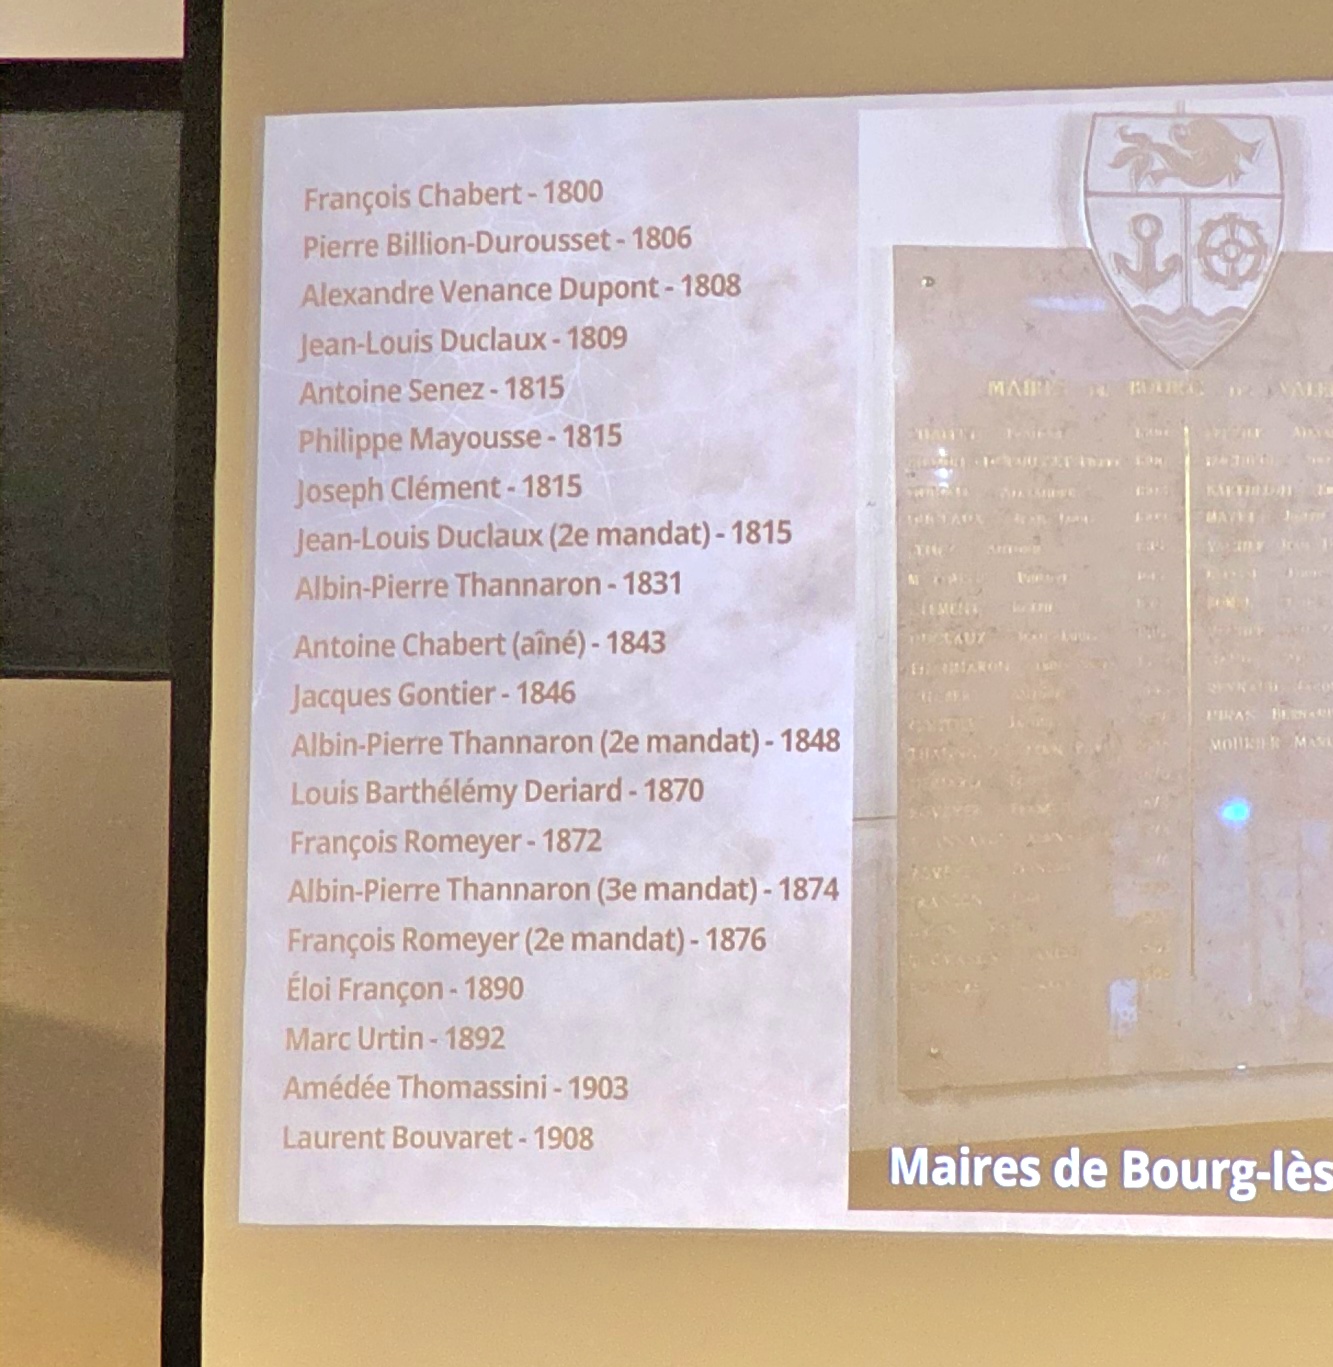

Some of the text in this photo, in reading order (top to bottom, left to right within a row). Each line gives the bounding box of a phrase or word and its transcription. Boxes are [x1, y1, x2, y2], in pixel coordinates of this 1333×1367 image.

[305, 179, 603, 216] François Chabert 1800
[304, 225, 692, 259] Pierre Billion-Durousset 1806
[301, 273, 741, 307] Alexandre Venance Dupont 1808
[298, 326, 627, 363] Jean-Louis Duclaux 1809
[299, 374, 565, 405] Antoine Senez 1815
[300, 423, 622, 460] Philippe Mayousse 1815
[294, 474, 582, 509] Joseph Clément 1815
[294, 519, 792, 557] Jean-Louis Duclaux (2e mandat) 1815
[295, 571, 680, 600] Albin-Pierre Thannaron 1831
[293, 629, 666, 660] Antoine Chabert (aîné) 1843
[290, 680, 576, 715] Jacques Gontier 1846
[292, 727, 840, 758] Albin-Pierre Thannaron (2e mandat) 1848
[292, 776, 704, 810] Louis Barthélémy Deriard 1870
[292, 828, 602, 860] François Romeyer 1872
[288, 875, 839, 906] Albin-Pierre Thannaron (3e mandat) 1874
[289, 926, 766, 959] François Romeyer (2e mandat) 1876
[287, 971, 524, 1007] Éloi Françon 1890
[286, 1025, 505, 1051] Marc Urtin 1892
[283, 1073, 628, 1100] Amédée Thomassini 1903
[284, 1126, 594, 1151] Laurent Bouvaret 1908
[892, 1147, 1040, 1187] Maires
[1055, 1148, 1107, 1188] de
